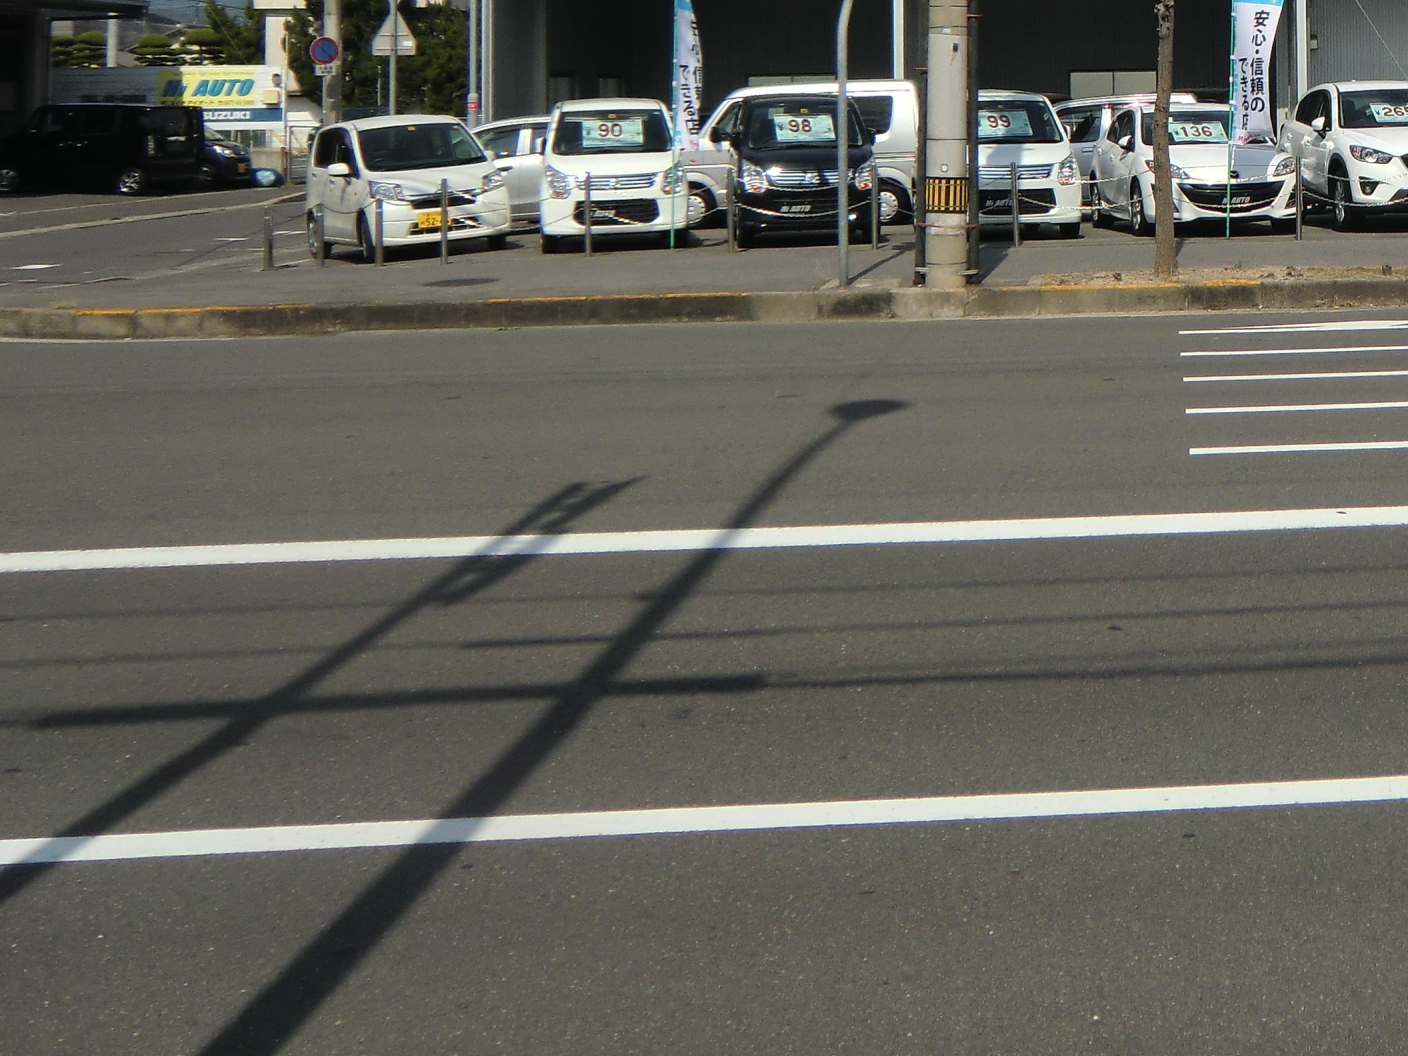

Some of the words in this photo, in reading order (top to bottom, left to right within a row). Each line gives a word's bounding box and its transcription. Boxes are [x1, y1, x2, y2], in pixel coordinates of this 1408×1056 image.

[1250, 9, 1270, 113] 安心・信頼の
[191, 78, 255, 97] AUTO
[203, 110, 251, 120] SUZUKI
[987, 115, 1011, 128] 99
[598, 123, 622, 137] 90
[788, 119, 812, 133] 98
[1180, 126, 1212, 137] 136
[1231, 196, 1250, 204] AUTO
